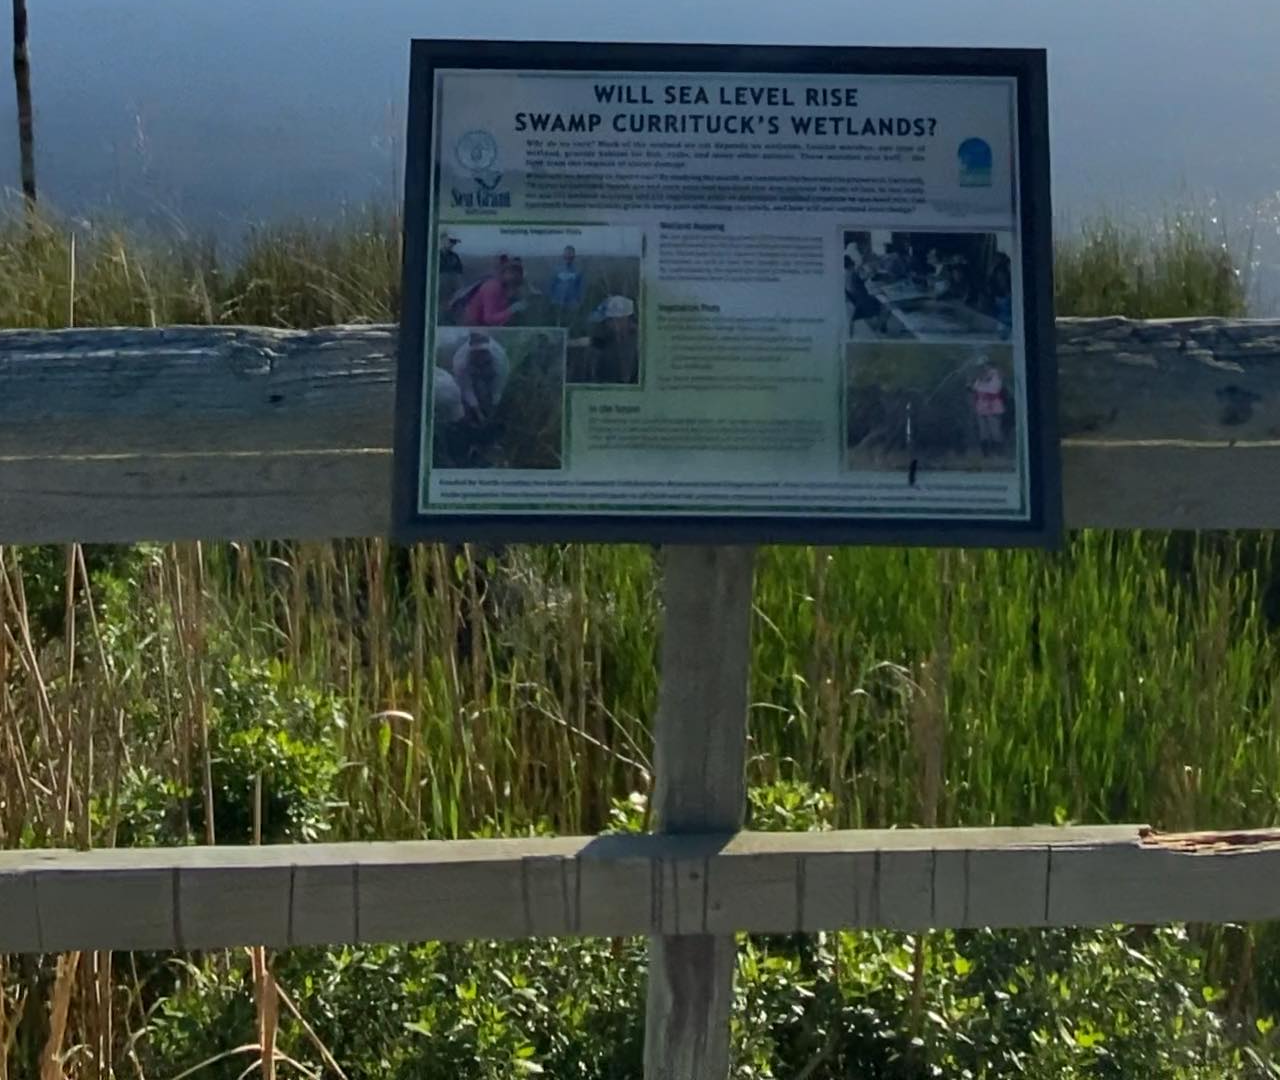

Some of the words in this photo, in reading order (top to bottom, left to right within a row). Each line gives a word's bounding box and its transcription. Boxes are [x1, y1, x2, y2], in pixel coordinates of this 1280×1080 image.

[594, 85, 653, 105] WILL
[664, 86, 709, 105] SEA
[720, 86, 795, 106] LEVEL
[805, 88, 858, 107] RISE
[514, 113, 602, 132] SWAMP
[612, 114, 780, 135] CURRITUCK'S
[790, 117, 937, 137] WETLANDS?
